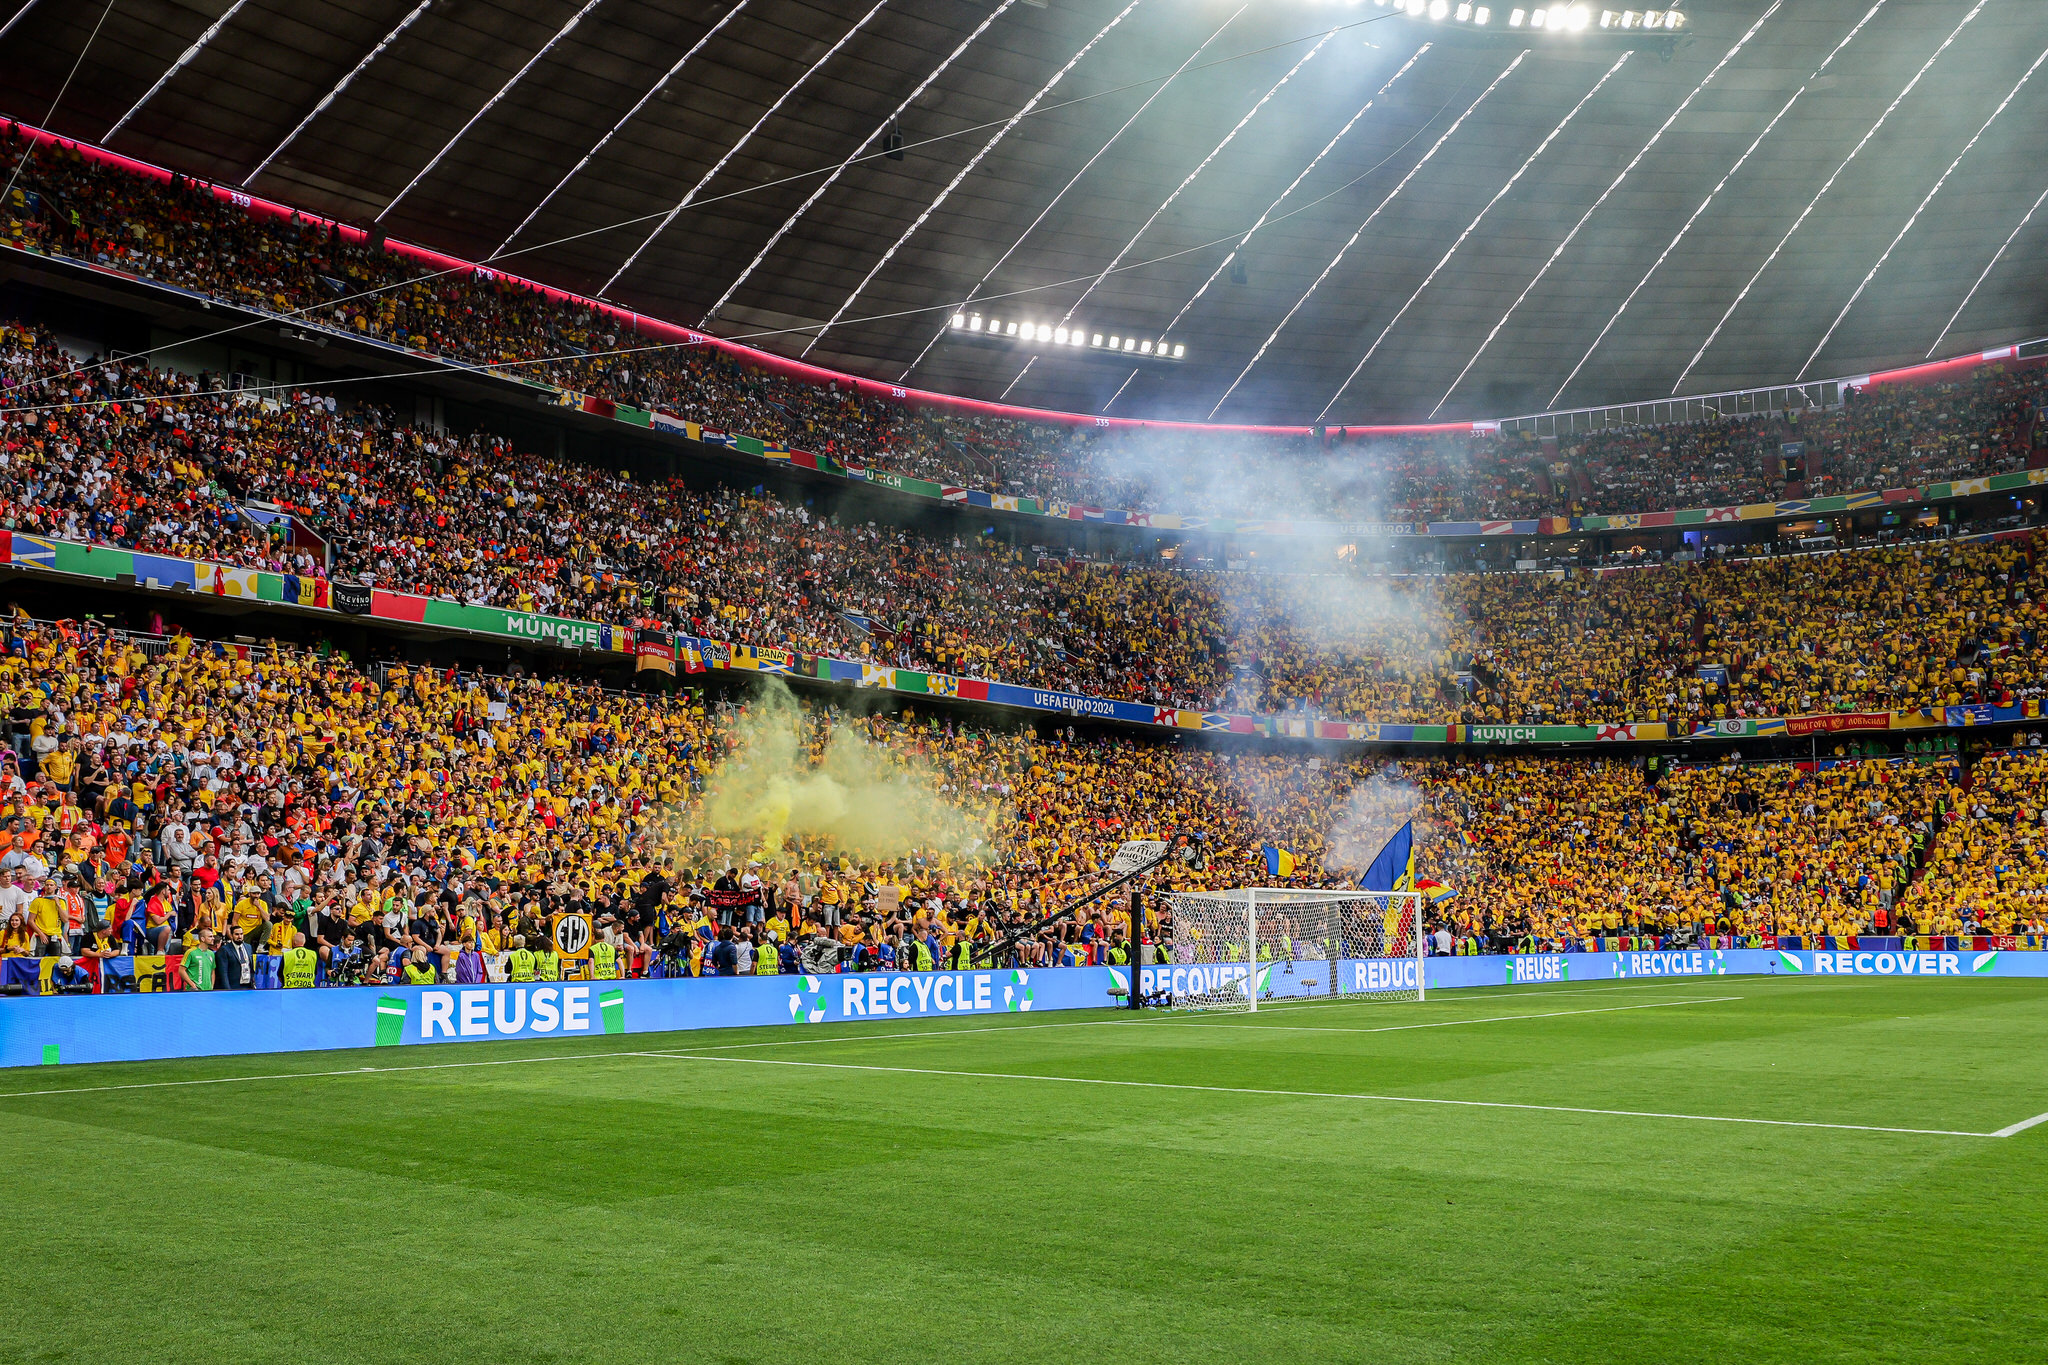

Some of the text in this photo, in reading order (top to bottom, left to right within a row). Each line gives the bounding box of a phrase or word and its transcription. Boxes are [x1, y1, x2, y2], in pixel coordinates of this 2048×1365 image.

[231, 191, 251, 208] 339
[891, 387, 906, 398] 336
[1095, 417, 1110, 427] 335
[758, 647, 787, 661] BANAT
[1473, 728, 1536, 740] MUNICH
[556, 915, 589, 953] FCD
[1516, 956, 1561, 981] REUSE
[1631, 952, 1703, 975] RECYCLE
[1814, 952, 1961, 975] RECOVER
[1140, 966, 1249, 998] RECOVER
[843, 974, 992, 1016] RECYCLE
[421, 987, 590, 1038] REUSE
